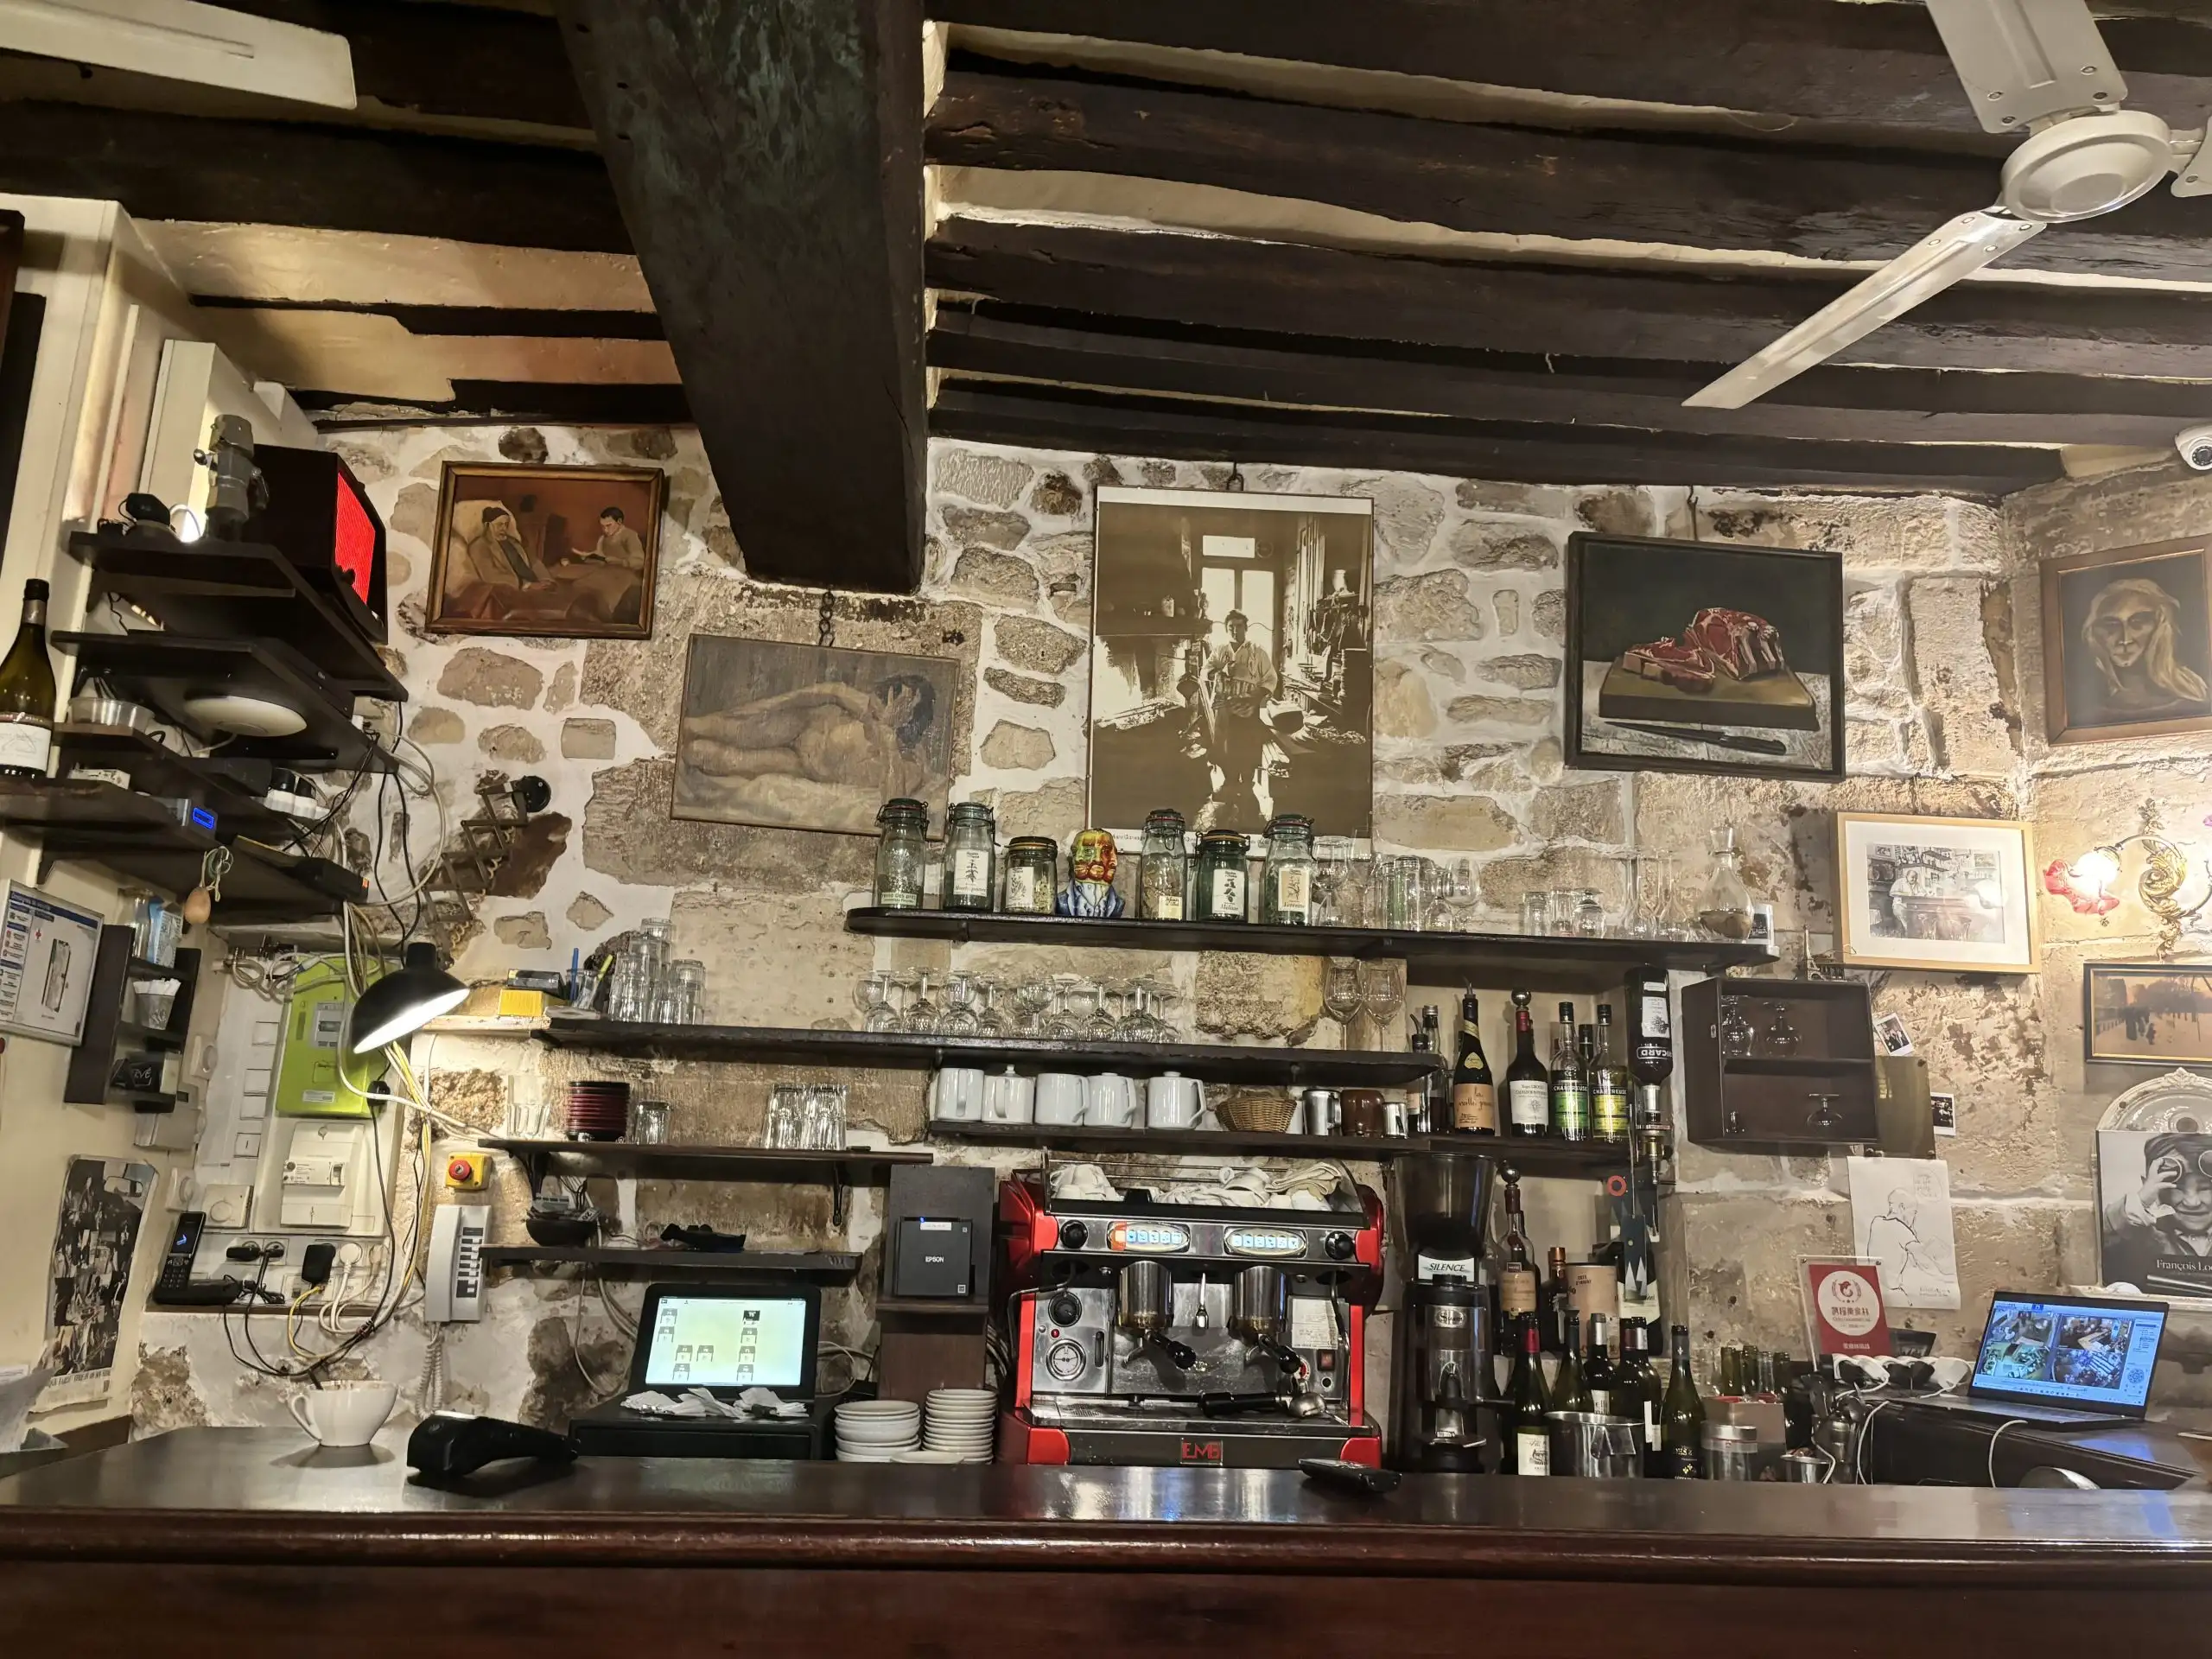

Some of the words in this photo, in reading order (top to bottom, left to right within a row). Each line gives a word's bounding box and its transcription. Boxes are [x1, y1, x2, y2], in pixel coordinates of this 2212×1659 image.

[1640, 1049, 1674, 1058] RICARD
[1430, 1262, 1465, 1272] SILENCE
[2157, 1259, 2196, 1272] François
